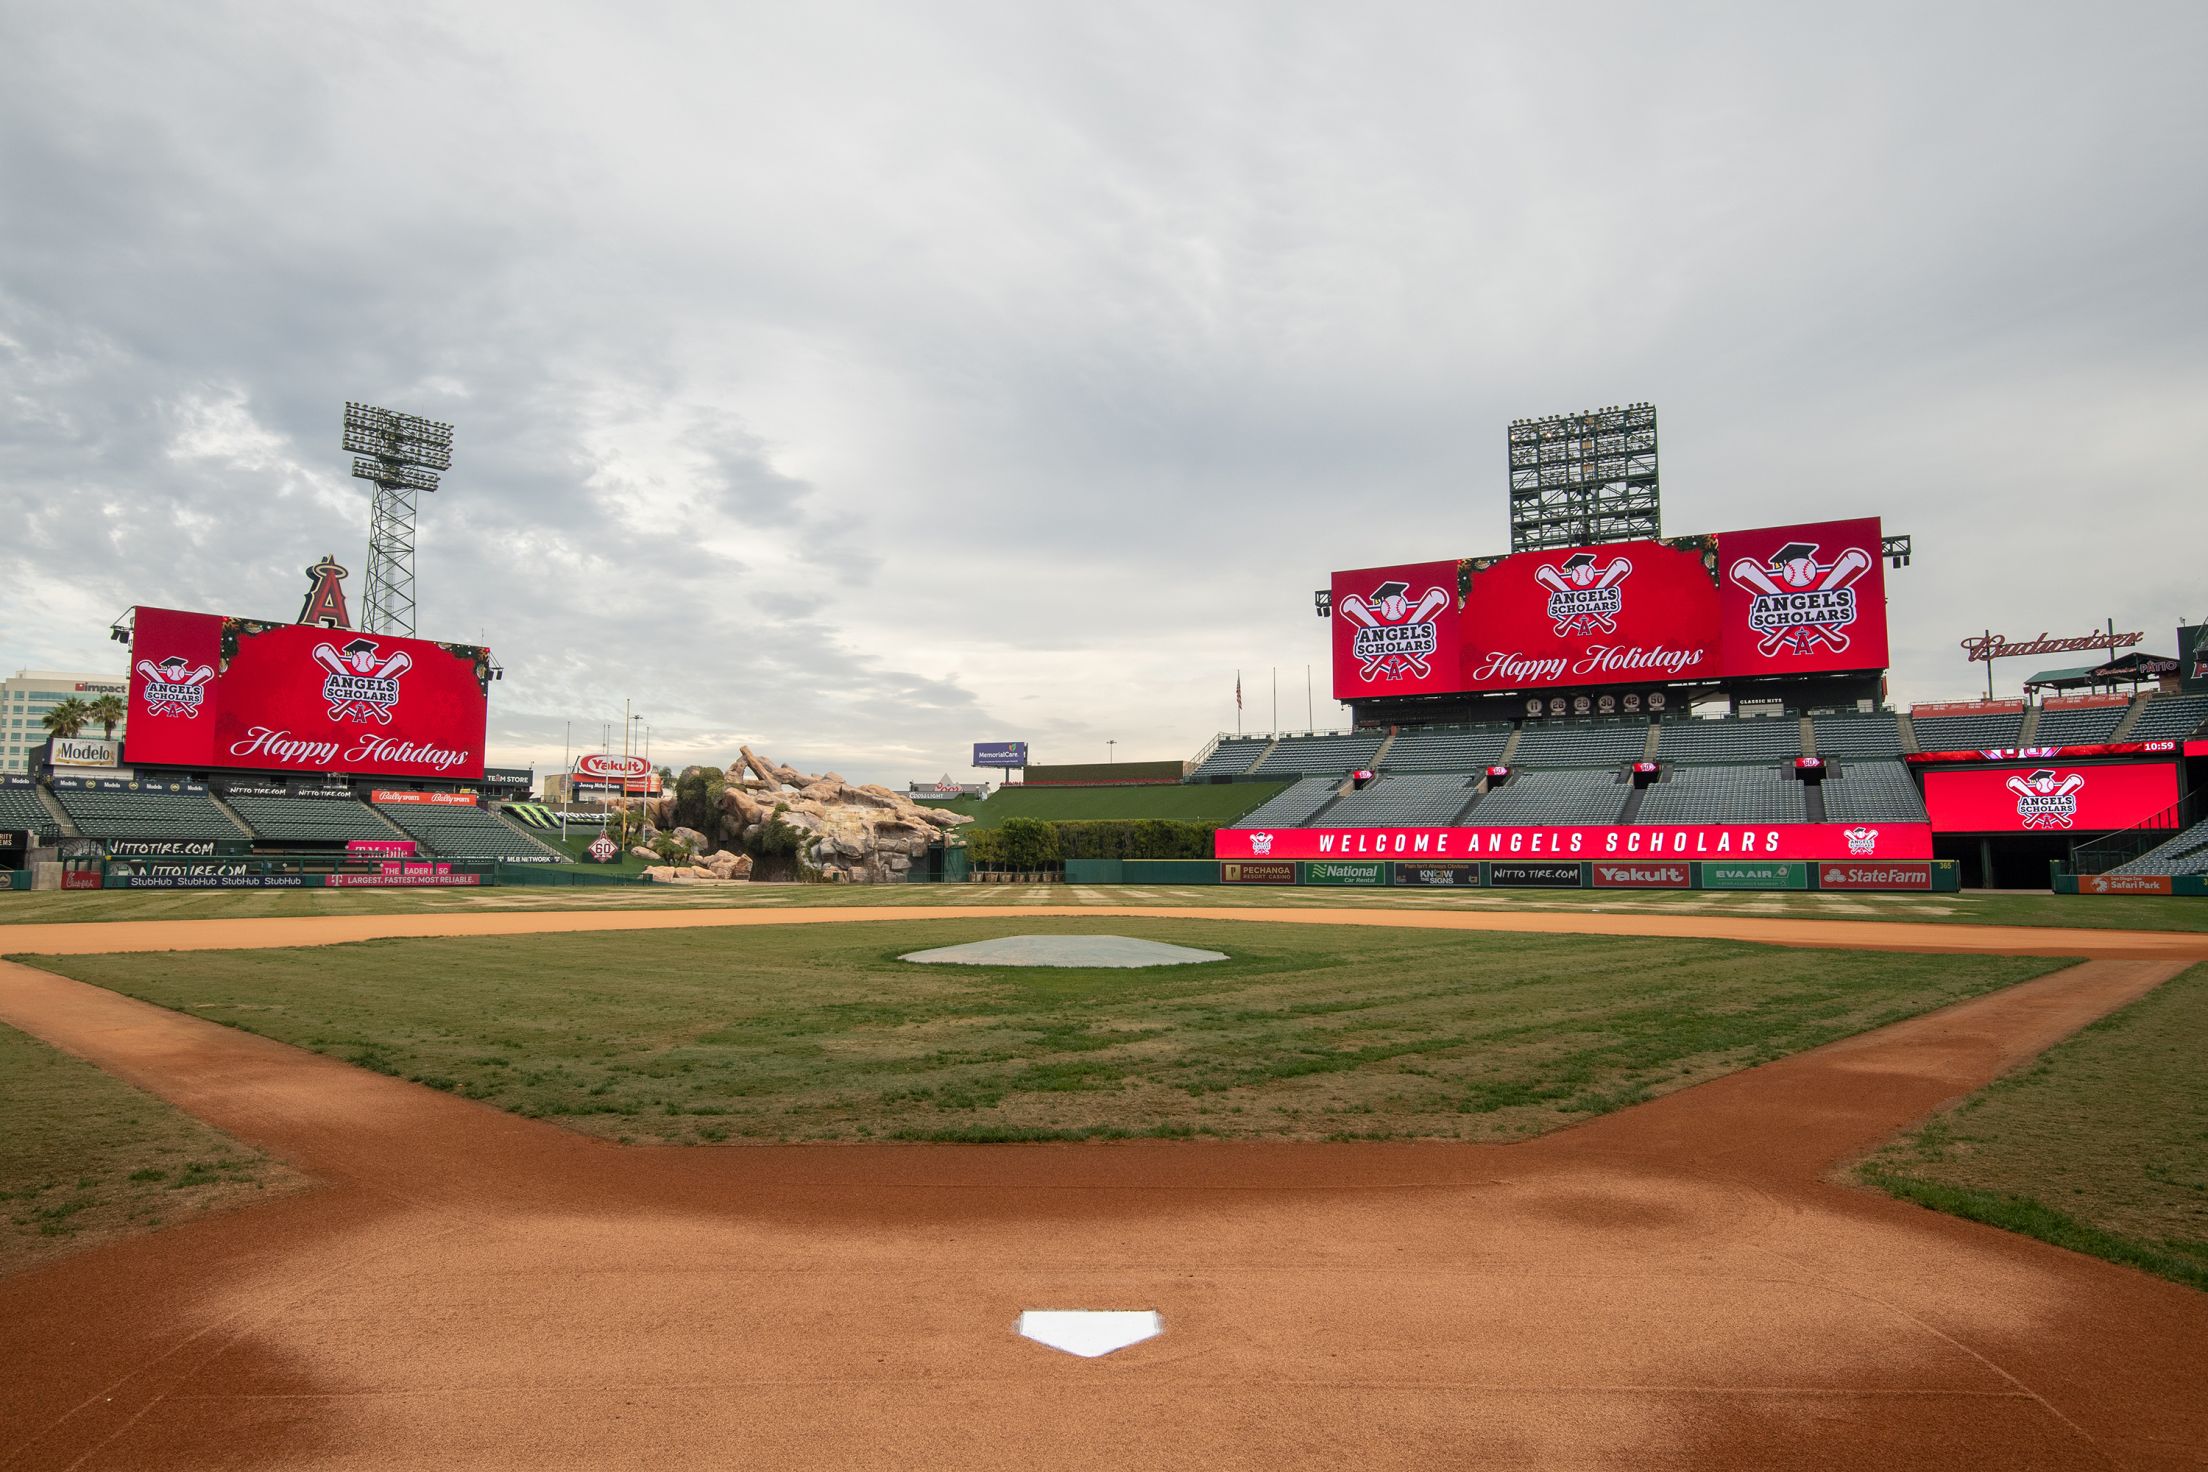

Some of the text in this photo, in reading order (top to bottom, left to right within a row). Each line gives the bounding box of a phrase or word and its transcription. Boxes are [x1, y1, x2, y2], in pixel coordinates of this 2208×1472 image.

[1552, 589, 1617, 605] ANGELS
[1755, 591, 1850, 613] ANGELS
[1550, 601, 1618, 614] SCHOLARS
[1754, 608, 1850, 626] SCHOLARS
[1358, 625, 1432, 643] ANGELS
[1357, 640, 1432, 655] SCHOLARS
[1960, 629, 2144, 662] Budweiser
[1472, 644, 1703, 682] Happy Holidays
[2140, 660, 2177, 673] PATIO
[84, 683, 126, 694] impact
[148, 683, 200, 695] ANGELS
[329, 675, 395, 692] ANGELS
[147, 691, 200, 702] SCHOLARS
[326, 687, 394, 702] SCHOLARS
[1650, 696, 1663, 704] 50
[1600, 698, 1612, 707] 30
[1625, 697, 1638, 705] 42
[60, 742, 110, 760] Modelo
[230, 726, 469, 771] Happy Holidays
[2144, 742, 2174, 751] 10:59
[591, 760, 641, 772] Yakult
[321, 790, 351, 798] TIRE.COM
[379, 791, 402, 802] Bally
[431, 793, 453, 804] Bally
[2021, 796, 2073, 806] ANGELS
[2020, 805, 2073, 813] SCHOLARS
[1319, 832, 1780, 852] WELCOME ANGELS SCHOLARS
[595, 844, 611, 854] 60
[1327, 864, 1378, 877] National
[1494, 869, 1578, 880] NITTO TIRE.COM
[1599, 868, 1684, 882] Yakult
[1716, 870, 1772, 878] EVA AIR
[131, 876, 302, 887] StubHub StubHub StubHub StubHub
[347, 876, 383, 884] LARGEST.
[384, 876, 417, 884] FASTEST.
[418, 876, 439, 884] MOST
[2111, 881, 2160, 889] Safari Park
